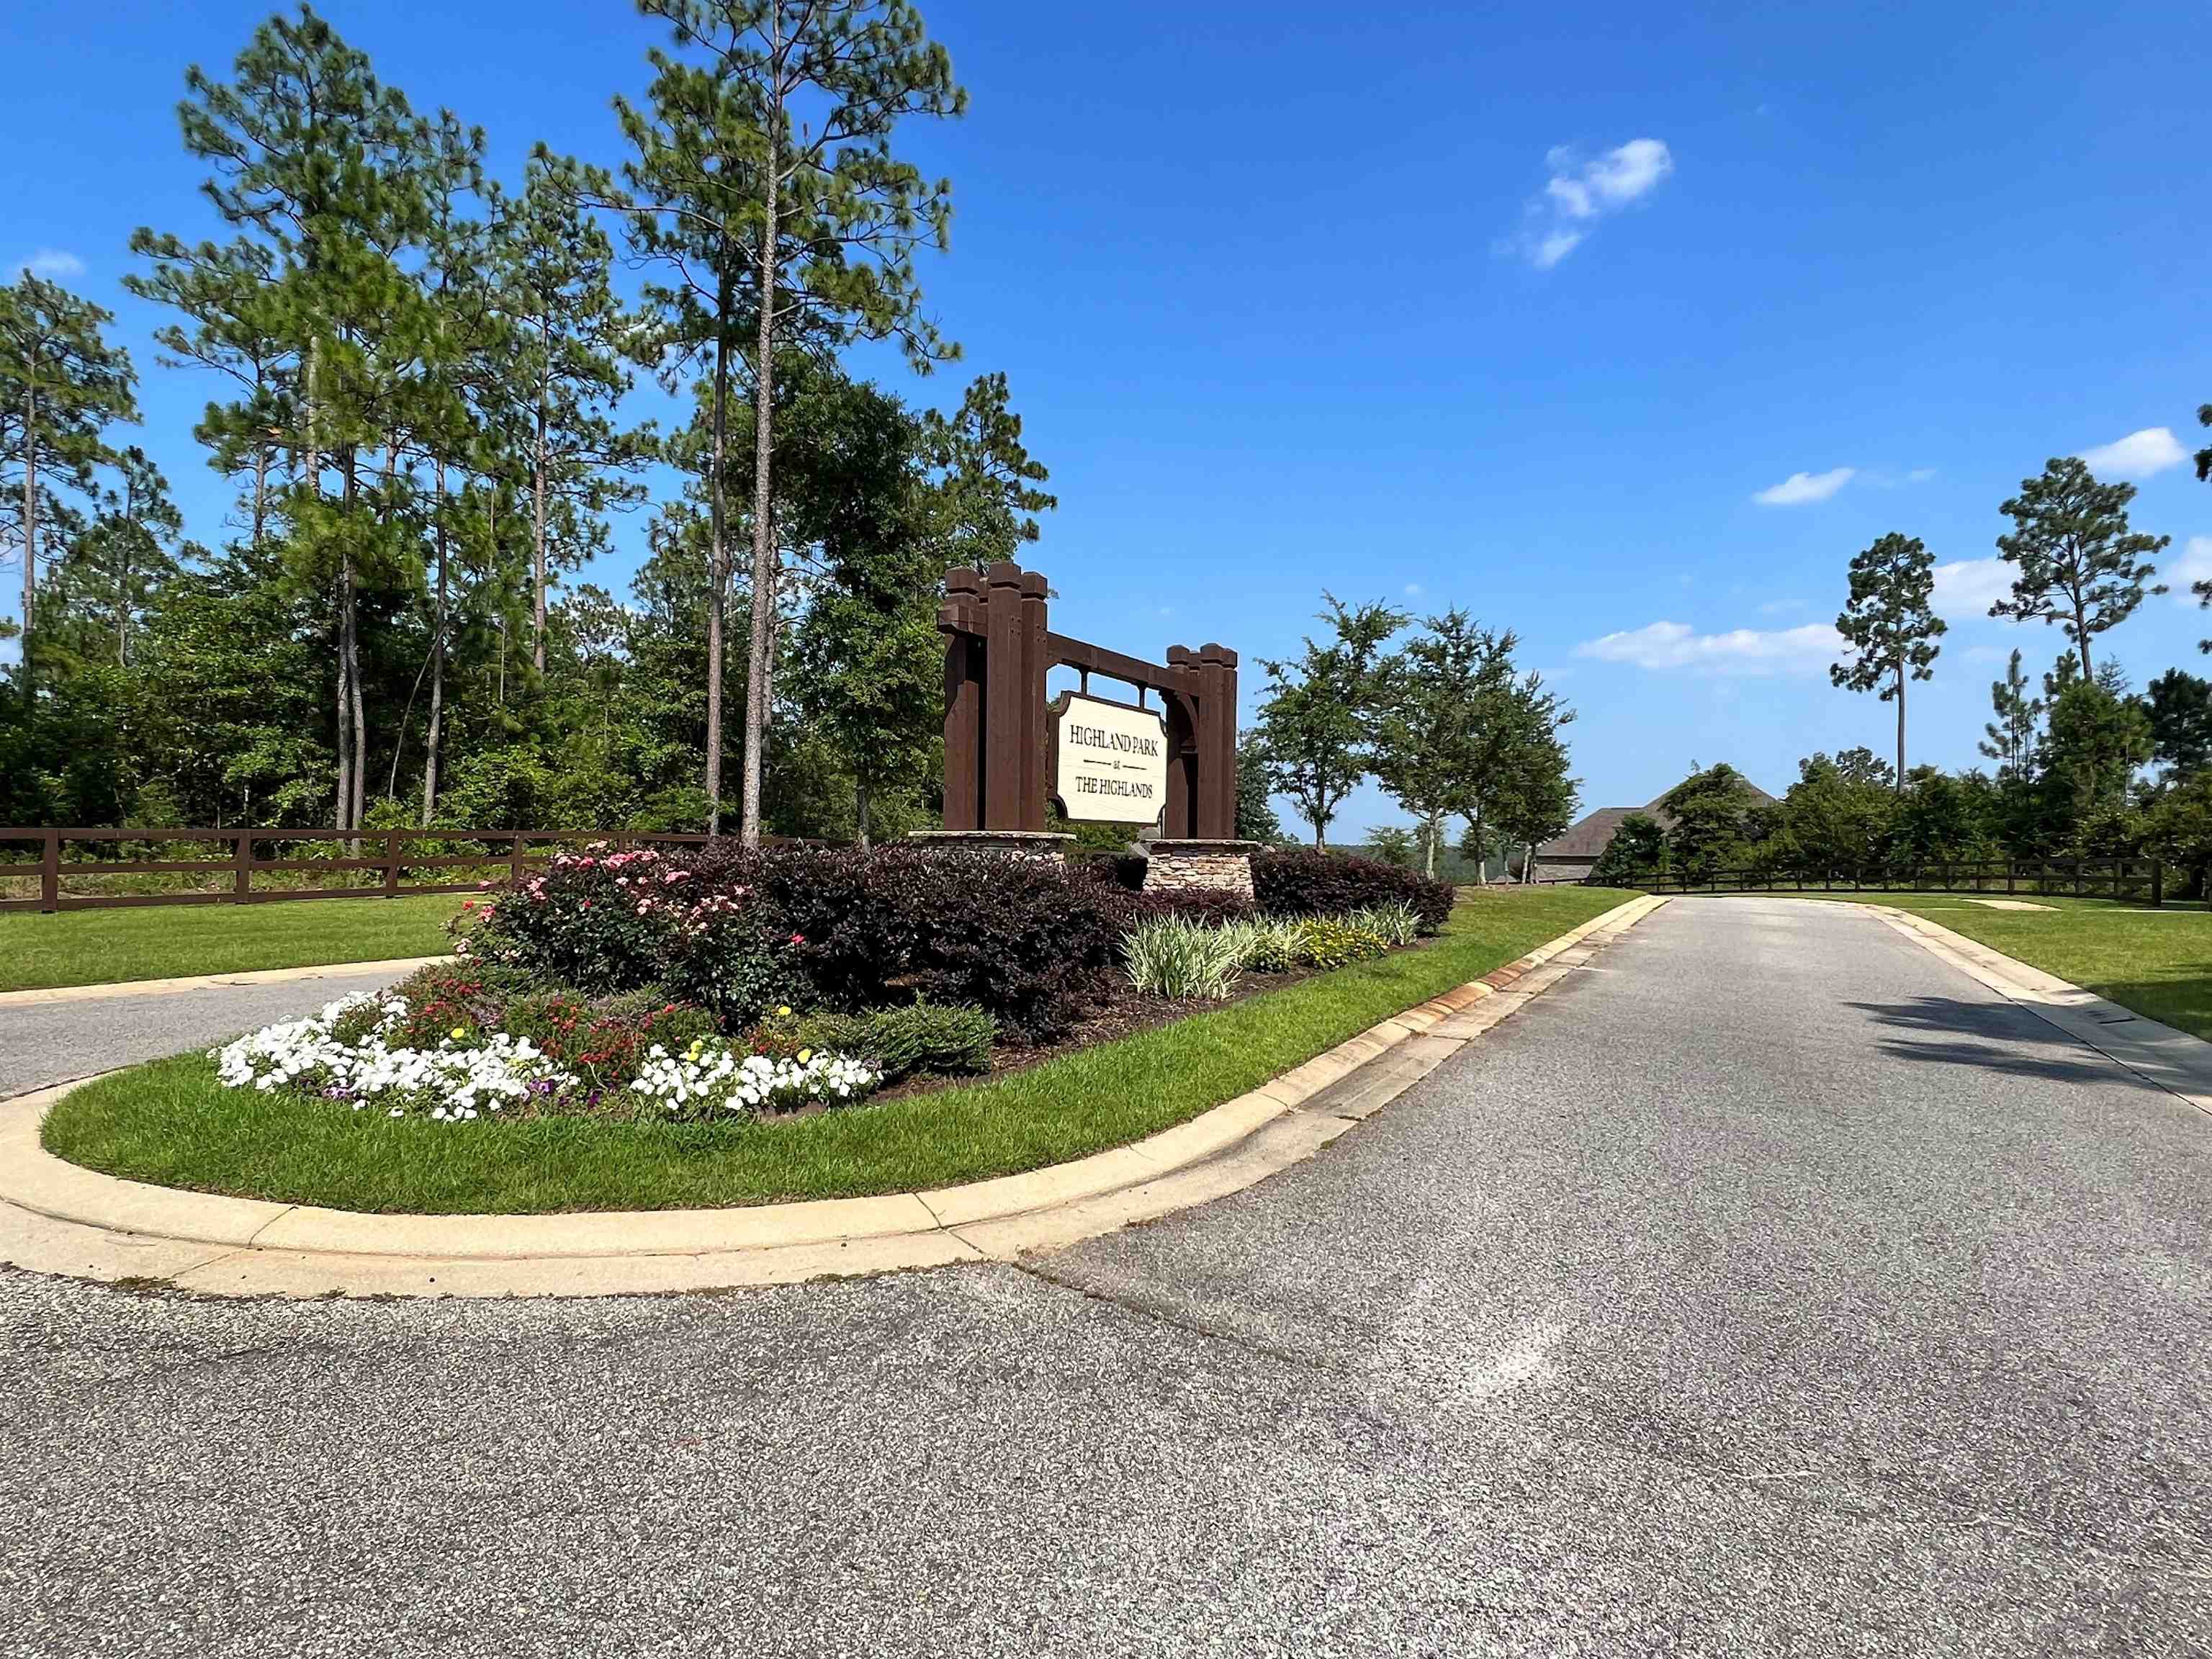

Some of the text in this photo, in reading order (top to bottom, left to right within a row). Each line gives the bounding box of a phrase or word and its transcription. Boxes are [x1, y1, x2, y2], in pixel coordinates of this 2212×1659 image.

[1069, 724, 1159, 757] HIGHLAND PARK
[1076, 776, 1153, 799] THE HIGHLANDS
